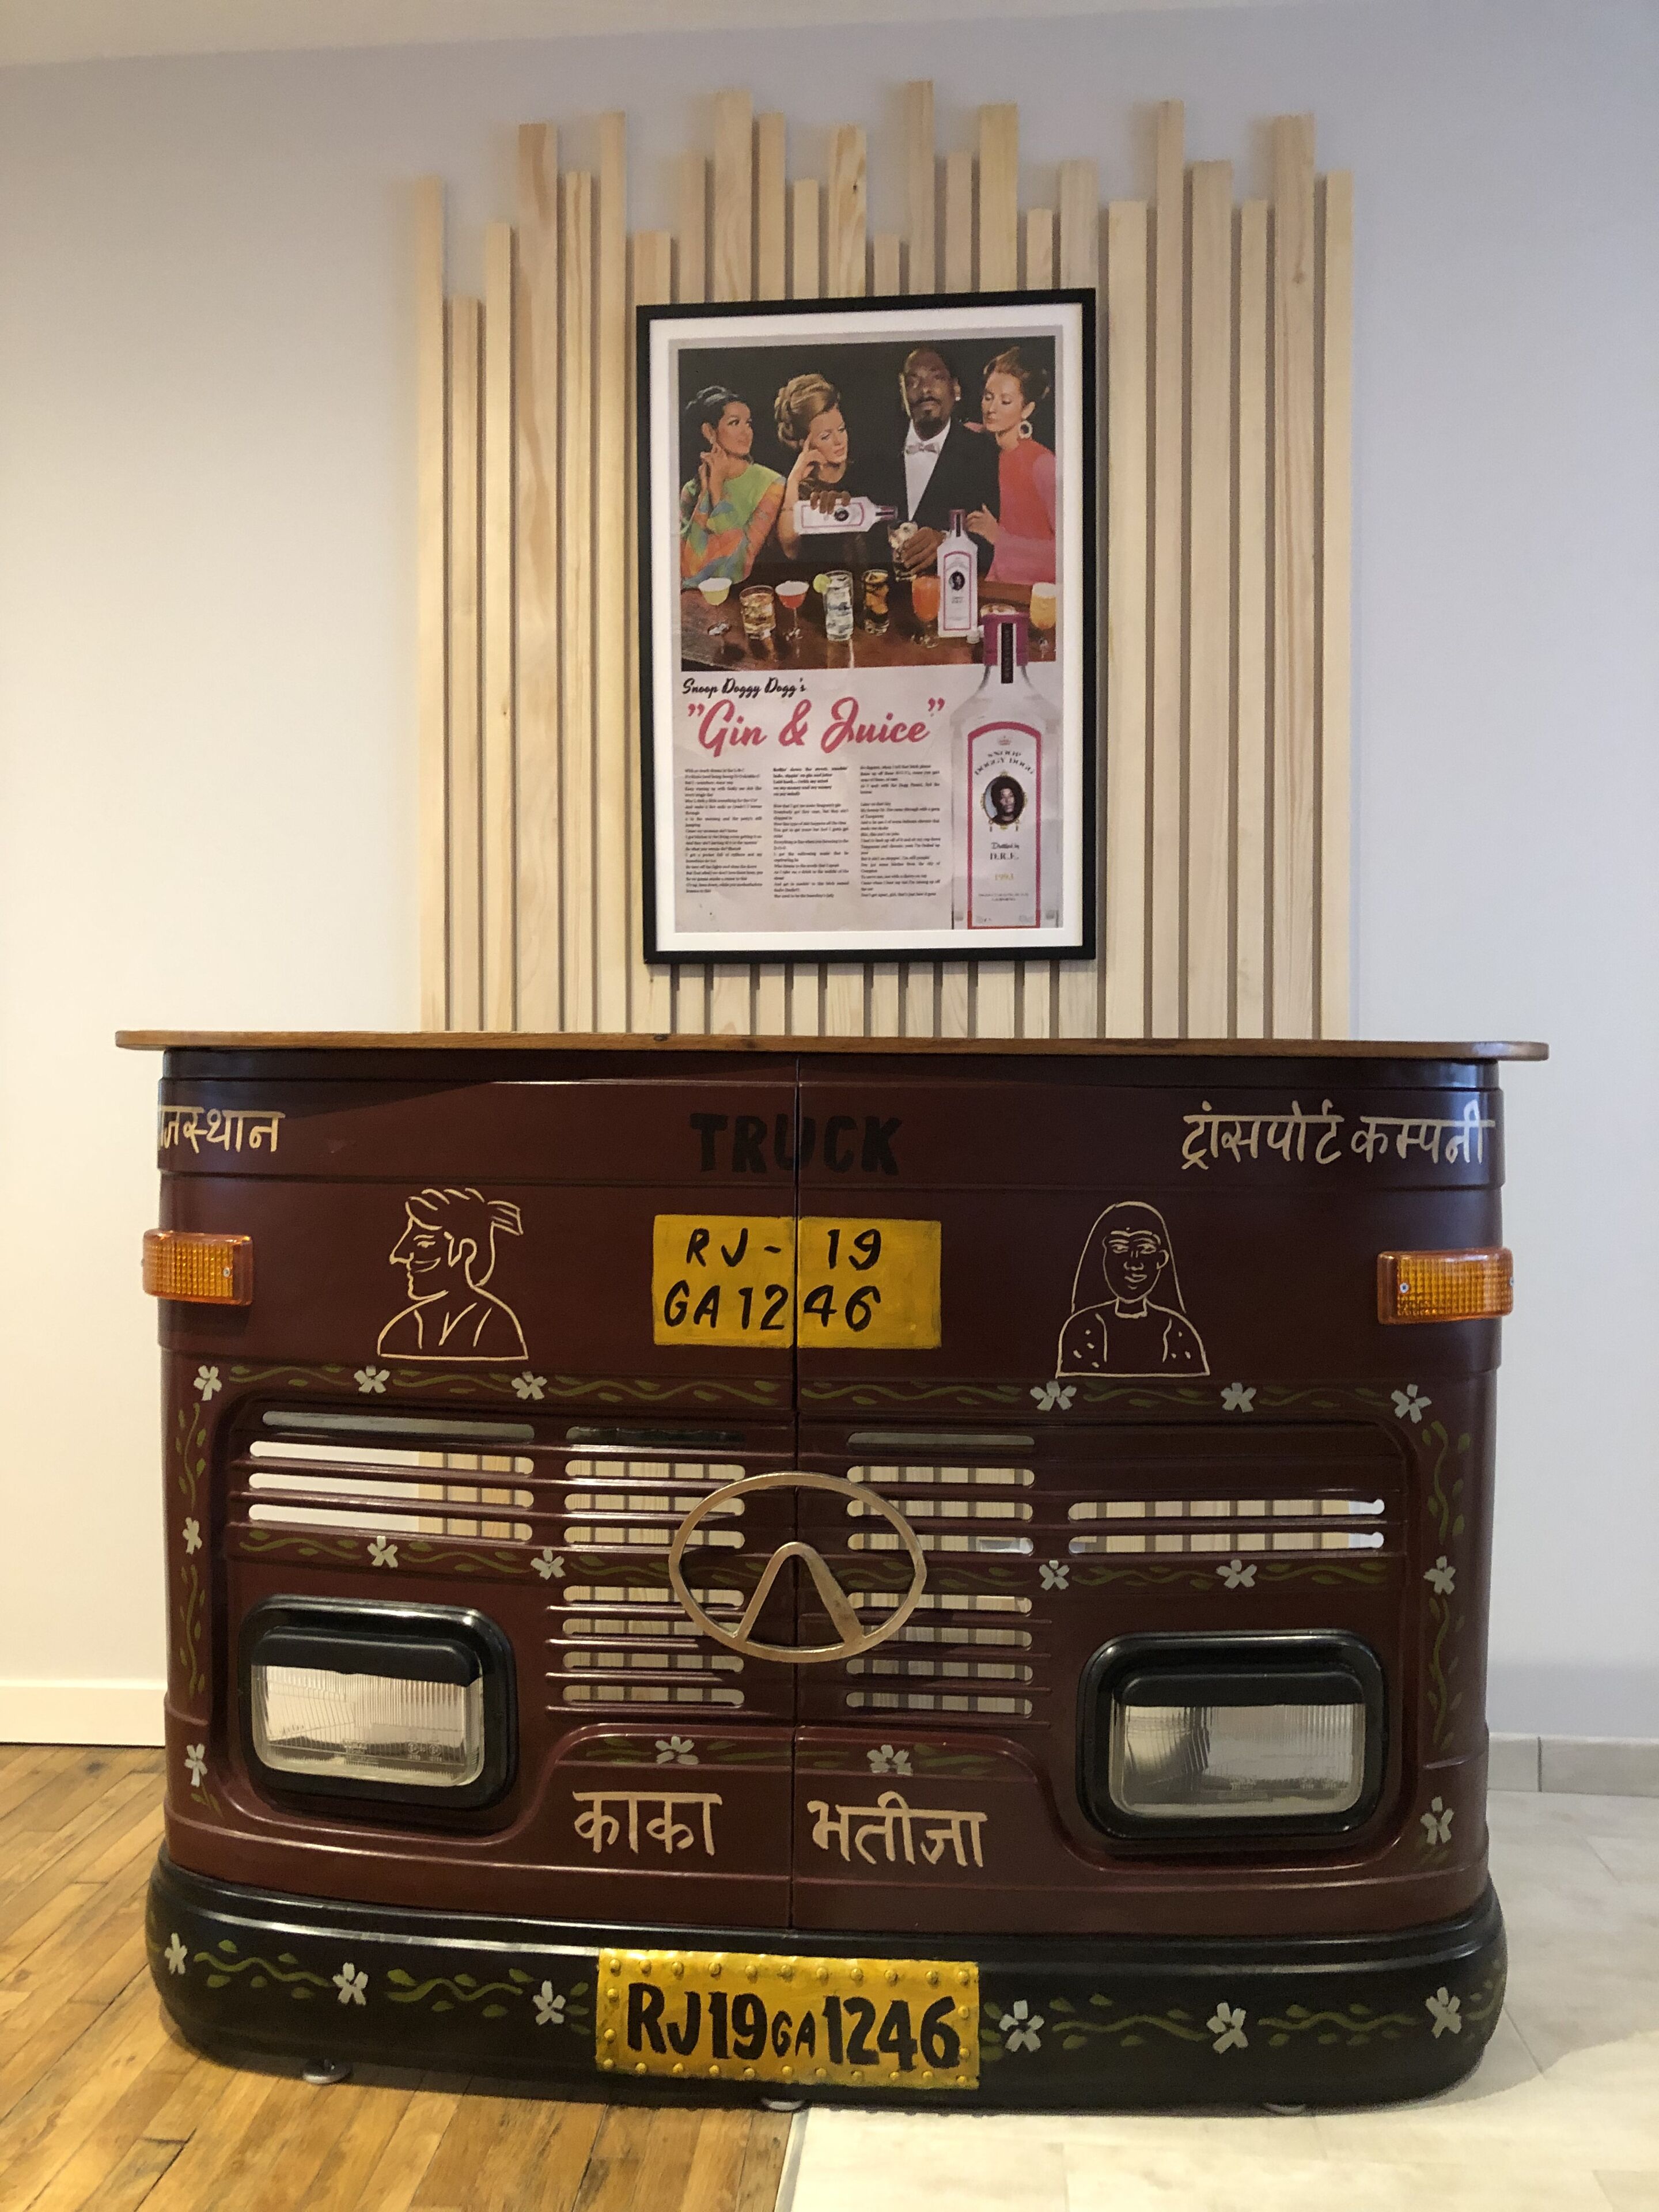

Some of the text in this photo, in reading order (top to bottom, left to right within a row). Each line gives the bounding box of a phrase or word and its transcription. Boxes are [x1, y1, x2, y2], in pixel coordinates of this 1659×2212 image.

[682, 677, 806, 698] Snoop Doggy Dogg's
[779, 699, 812, 747] &
[691, 1112, 902, 1176] TRUCK
[1351, 1099, 1496, 1164] कम्पनी
[572, 1791, 722, 1855] काका
[807, 1790, 988, 1868] भतीजा
